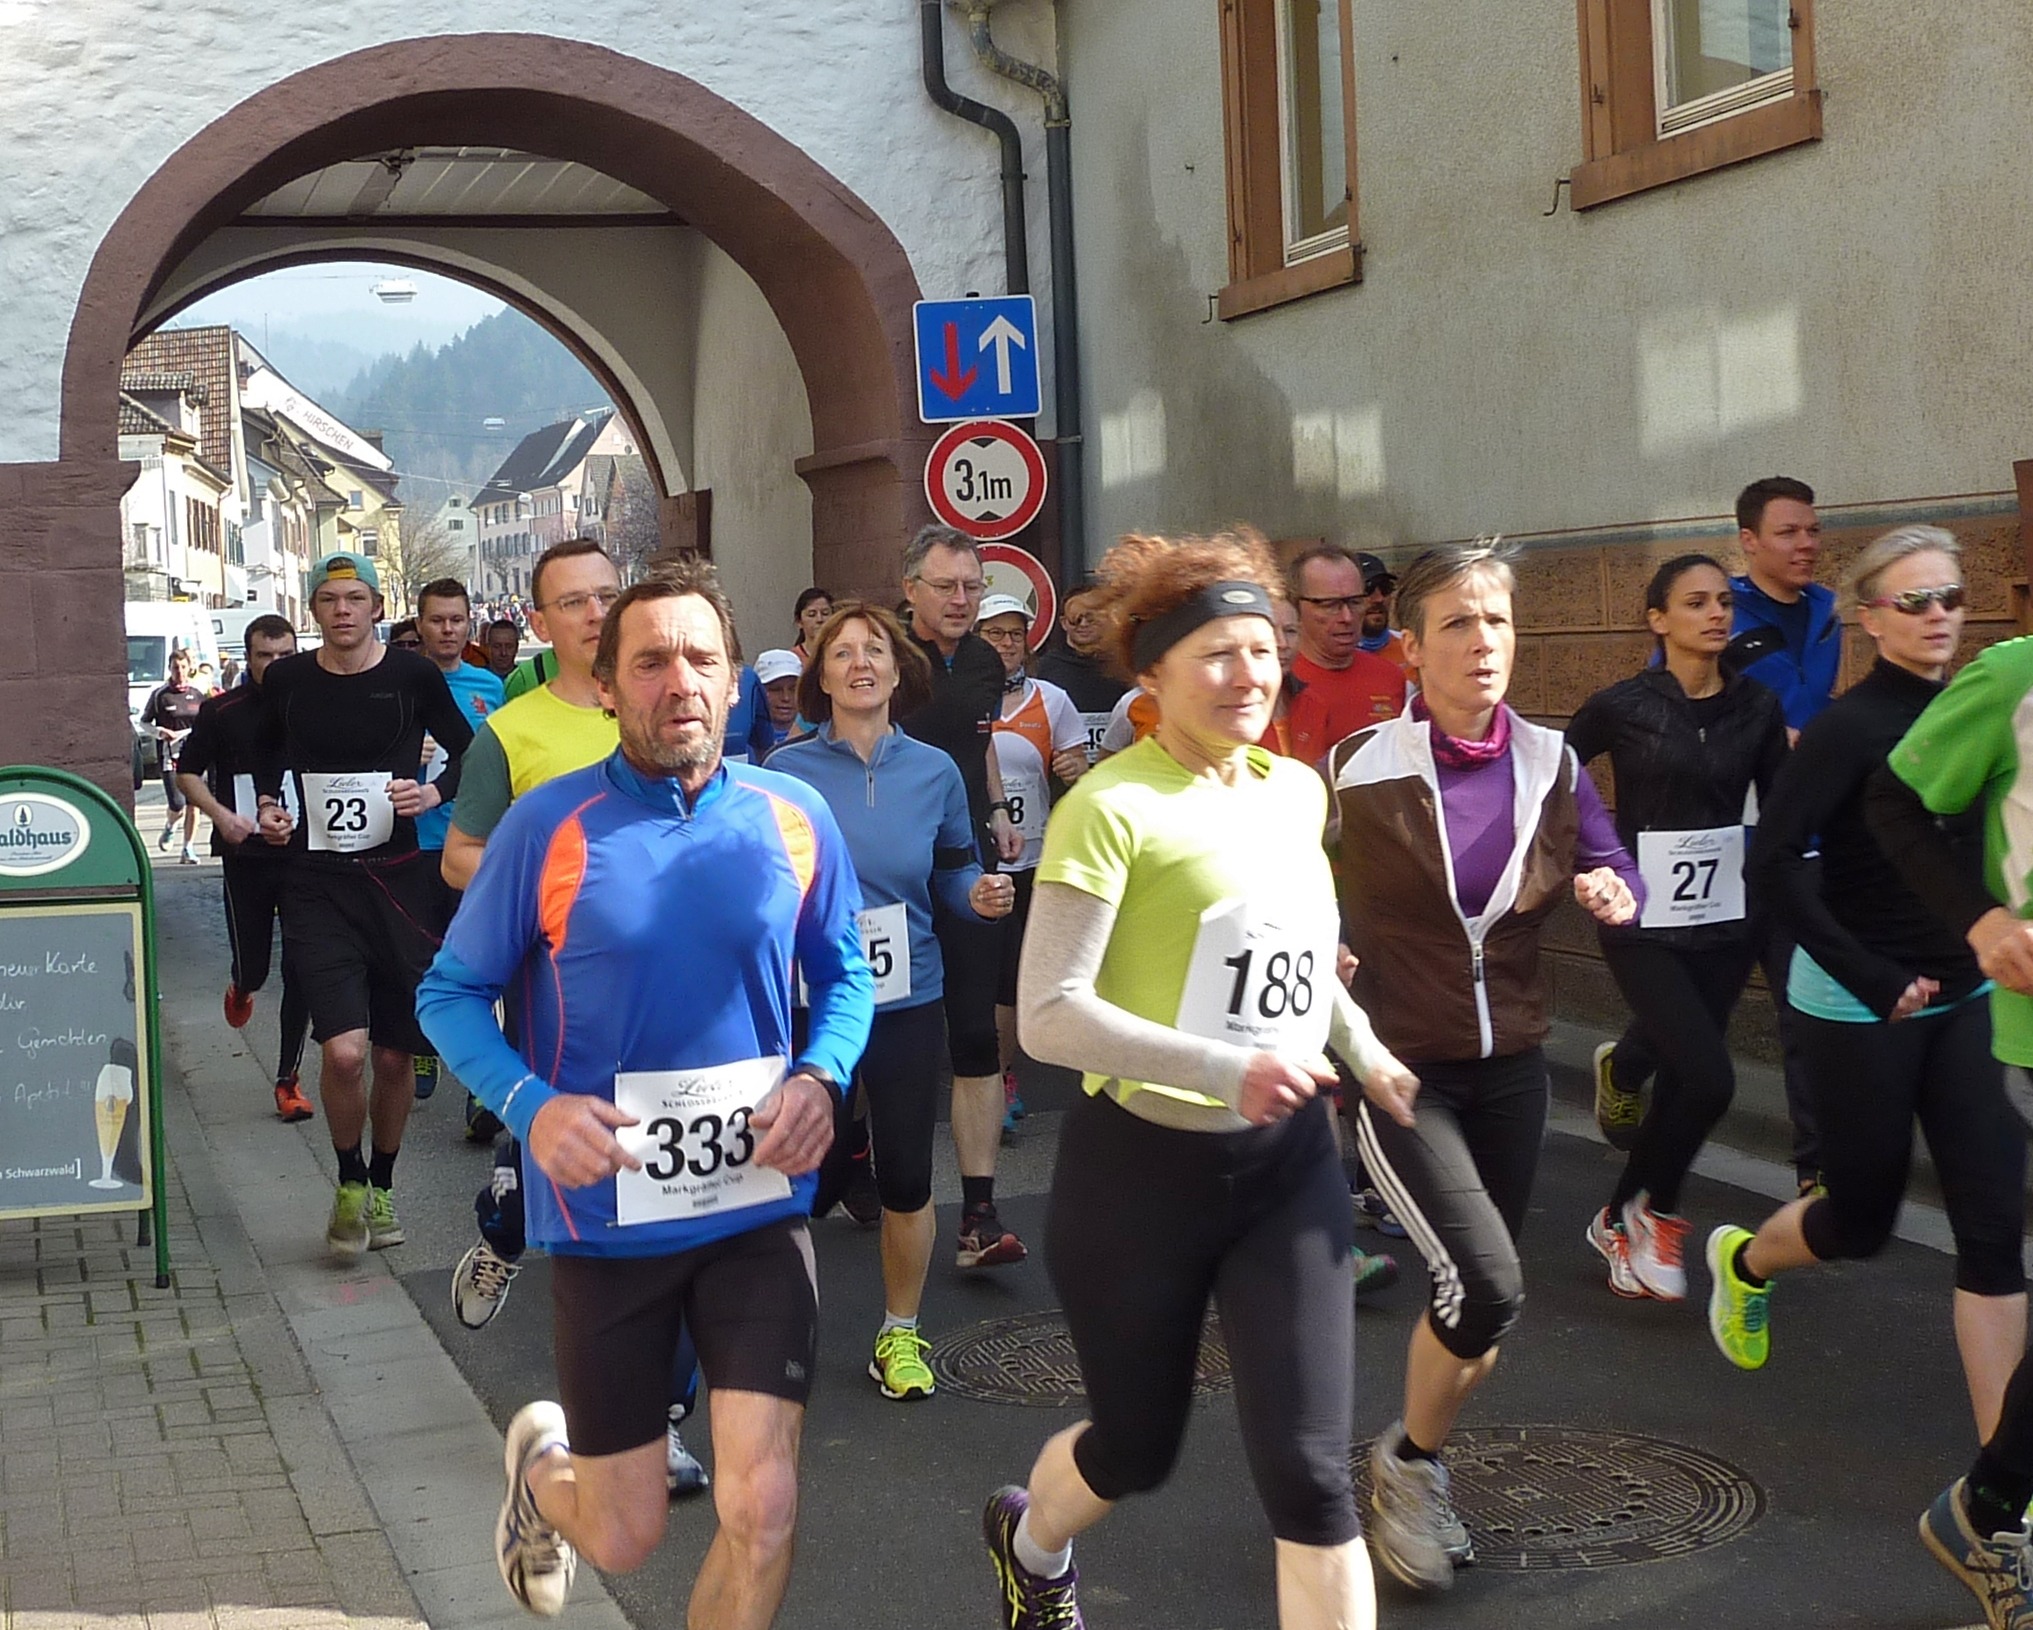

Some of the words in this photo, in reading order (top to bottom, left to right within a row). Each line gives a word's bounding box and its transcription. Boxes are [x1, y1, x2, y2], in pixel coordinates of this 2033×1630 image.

[302, 410, 354, 451] HIRSCHEN
[954, 459, 1012, 503] 3,1m
[325, 798, 368, 832] 23
[1004, 796, 1025, 825] 8
[0, 828, 72, 850] aldhaus
[1671, 858, 1719, 902] 27
[45, 950, 99, 975] Karte
[868, 937, 893, 978] 5
[1224, 949, 1314, 1019] 188
[645, 1106, 755, 1180] 333
